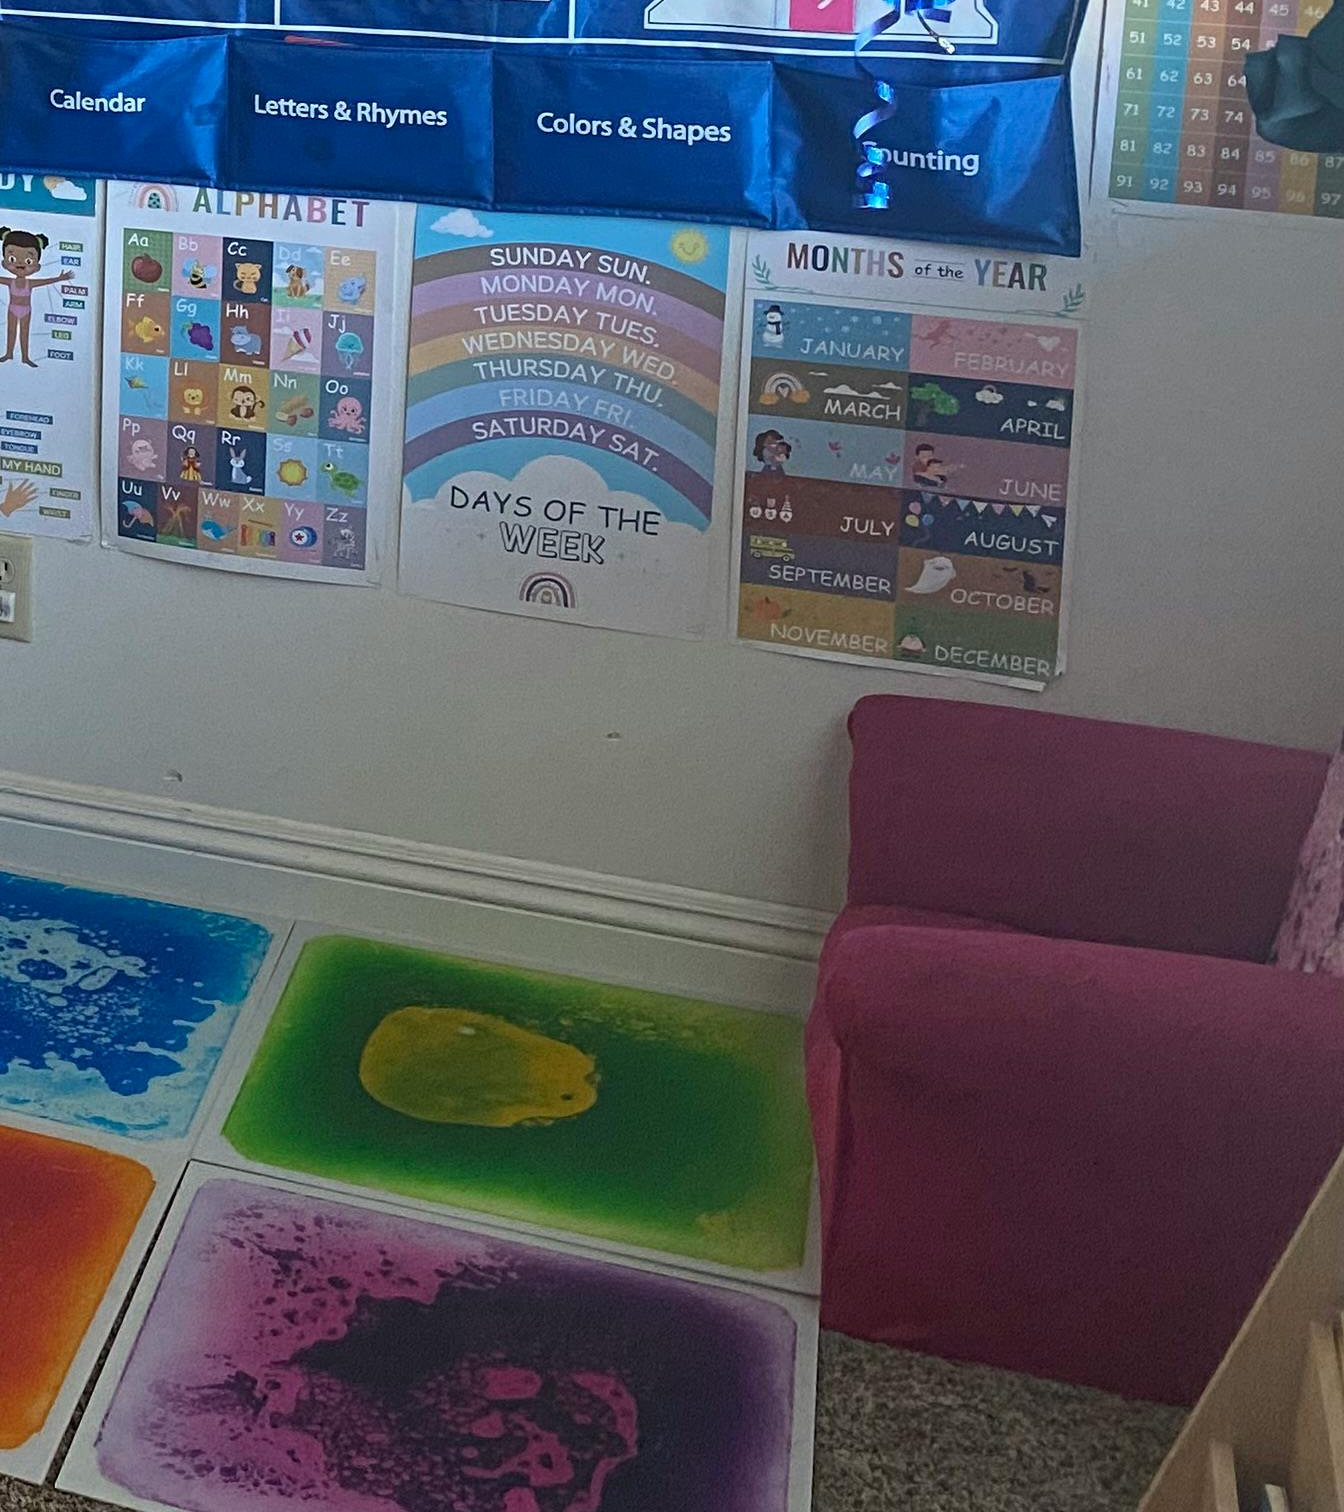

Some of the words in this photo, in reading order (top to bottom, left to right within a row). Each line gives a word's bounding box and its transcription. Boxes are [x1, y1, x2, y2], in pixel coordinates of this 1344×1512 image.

[49, 88, 146, 114] Calendar
[254, 94, 329, 122] Letters
[333, 101, 352, 123] &
[355, 101, 448, 128] Rhymes
[536, 112, 612, 138] Colors
[617, 117, 638, 139] &
[641, 117, 732, 146] Shapes
[192, 187, 370, 227] ALPHABET
[128, 233, 149, 246] Aa
[178, 238, 199, 252] Bb
[227, 242, 248, 256] Cc
[279, 246, 301, 261] Dd
[330, 251, 351, 266] Ee
[490, 247, 592, 268] SUNDAY
[597, 256, 651, 285] SUN.
[787, 242, 905, 278] MONTHS
[914, 263, 932, 276] of
[937, 265, 964, 280] the
[973, 258, 1048, 292] YEAR
[125, 294, 144, 308] Ff
[480, 275, 591, 297] MONDAY
[596, 286, 657, 315] MON.
[176, 299, 197, 316] Gg
[226, 304, 249, 319] Hh
[328, 314, 346, 332] Jj
[473, 303, 588, 326] TUESDAY
[596, 312, 659, 348] TUES.
[461, 332, 615, 356] WEDNESDAY
[623, 345, 678, 386] WED.
[800, 338, 904, 363] JANUARY
[125, 357, 144, 371] Kk
[174, 362, 188, 377] Ll
[955, 351, 1069, 377] FEBRUARY
[224, 369, 252, 385] Mm
[274, 374, 297, 389] Nn
[472, 358, 606, 385] THURSDAY
[614, 372, 663, 408] THU.
[325, 379, 349, 395] Oo
[499, 389, 589, 412] FRIDAY
[594, 399, 634, 427] FRI.
[824, 399, 901, 421] MARCH
[122, 418, 140, 435] Pp
[172, 424, 196, 444] Qq
[1000, 418, 1065, 440] APRIL
[222, 431, 240, 446] Rr
[273, 438, 292, 452] Ss
[472, 418, 605, 444] SATURDAY
[608, 434, 660, 472] SAT.
[324, 444, 343, 459] Tt
[2, 458, 22, 471] MY
[25, 460, 61, 476] HAND
[849, 463, 898, 482] MAY
[122, 482, 142, 496] Uu
[162, 487, 181, 502] Vv
[999, 479, 1061, 501] JUNE
[202, 492, 230, 507] Ww
[242, 498, 265, 513] Xx
[284, 503, 304, 520] Yy
[326, 508, 348, 522] Zz
[450, 485, 532, 517] DAYS
[543, 499, 586, 524] OF
[598, 505, 661, 535] THE
[840, 516, 895, 537] JULY
[499, 521, 605, 565] WEEK
[964, 531, 1059, 556] AUGUST
[769, 564, 891, 595] SEPTEMBER
[950, 588, 1054, 615] OCTOBER
[770, 622, 888, 654] NOVEMBER
[935, 644, 1052, 677] DECEMBER
